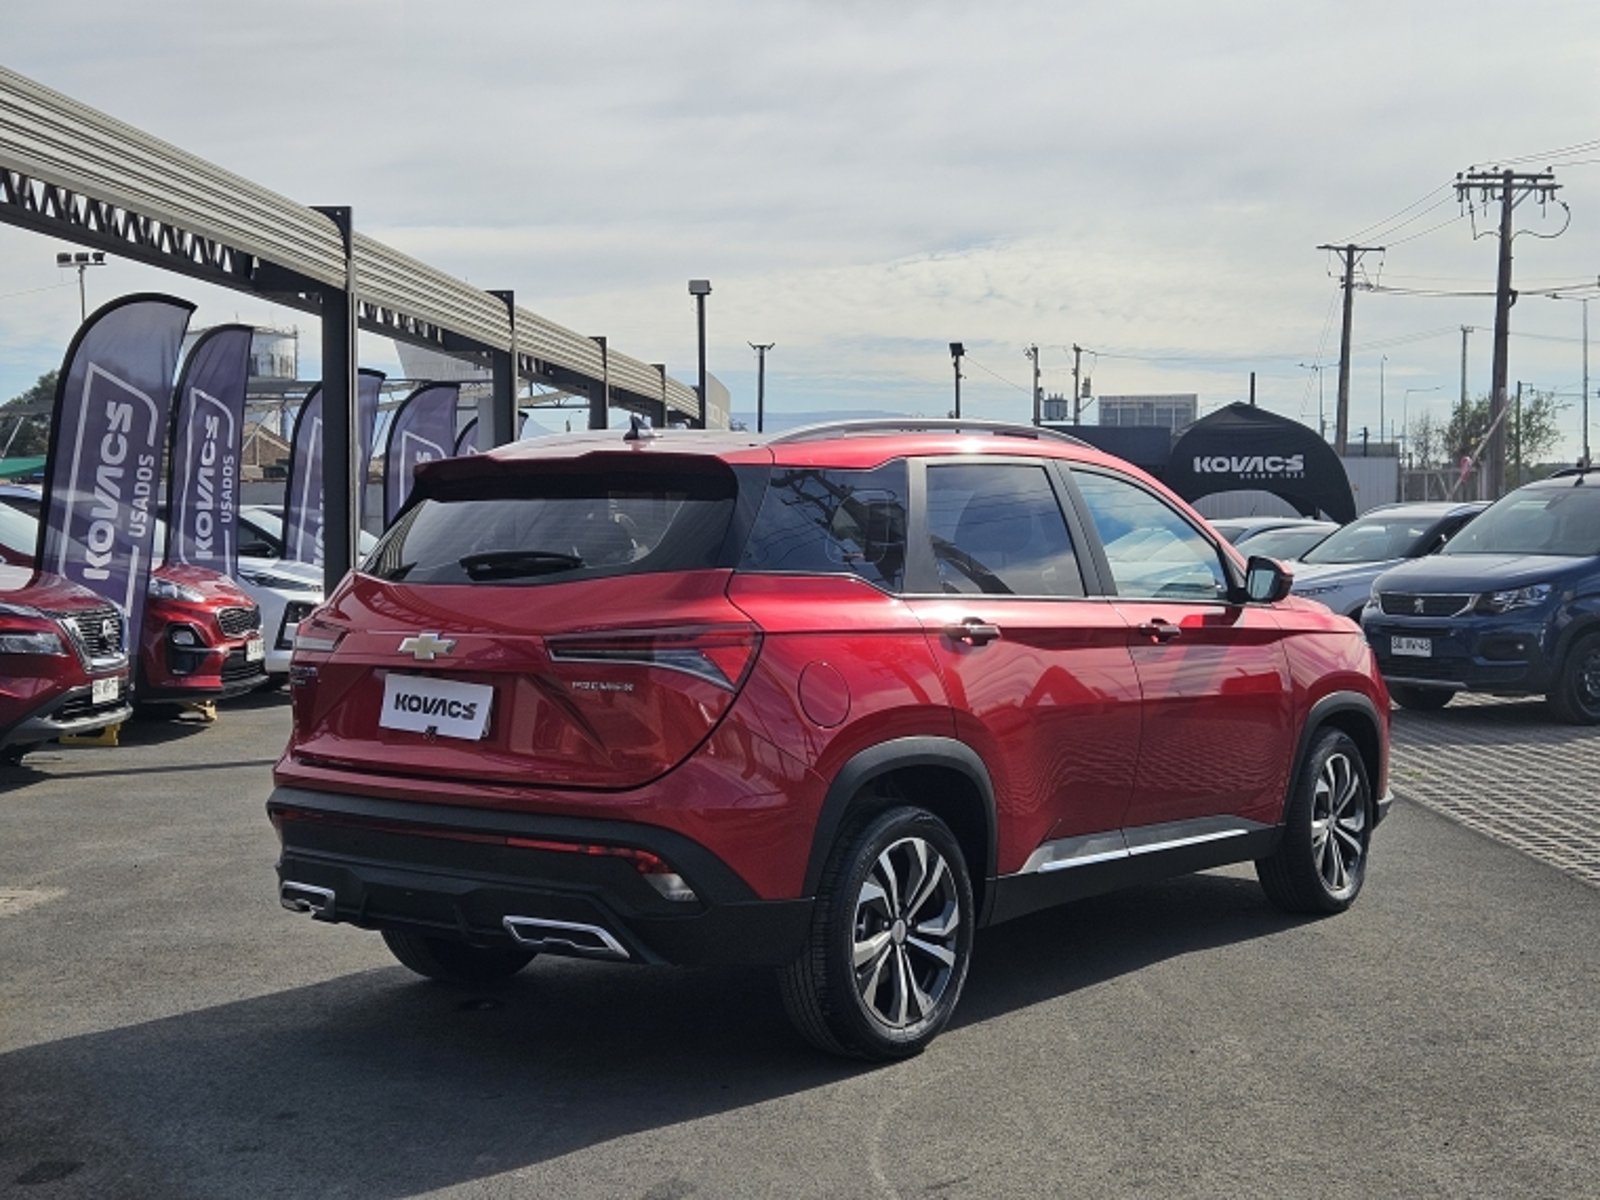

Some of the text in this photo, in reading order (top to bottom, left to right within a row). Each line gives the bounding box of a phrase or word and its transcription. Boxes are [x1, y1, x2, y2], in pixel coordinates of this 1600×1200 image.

[82, 400, 134, 580] KOVACS
[127, 453, 155, 538] USADOS
[195, 414, 220, 560] KOVACS
[220, 455, 235, 524] USADOS
[1193, 453, 1305, 473] KOVACS
[393, 692, 479, 721] KOVACS
